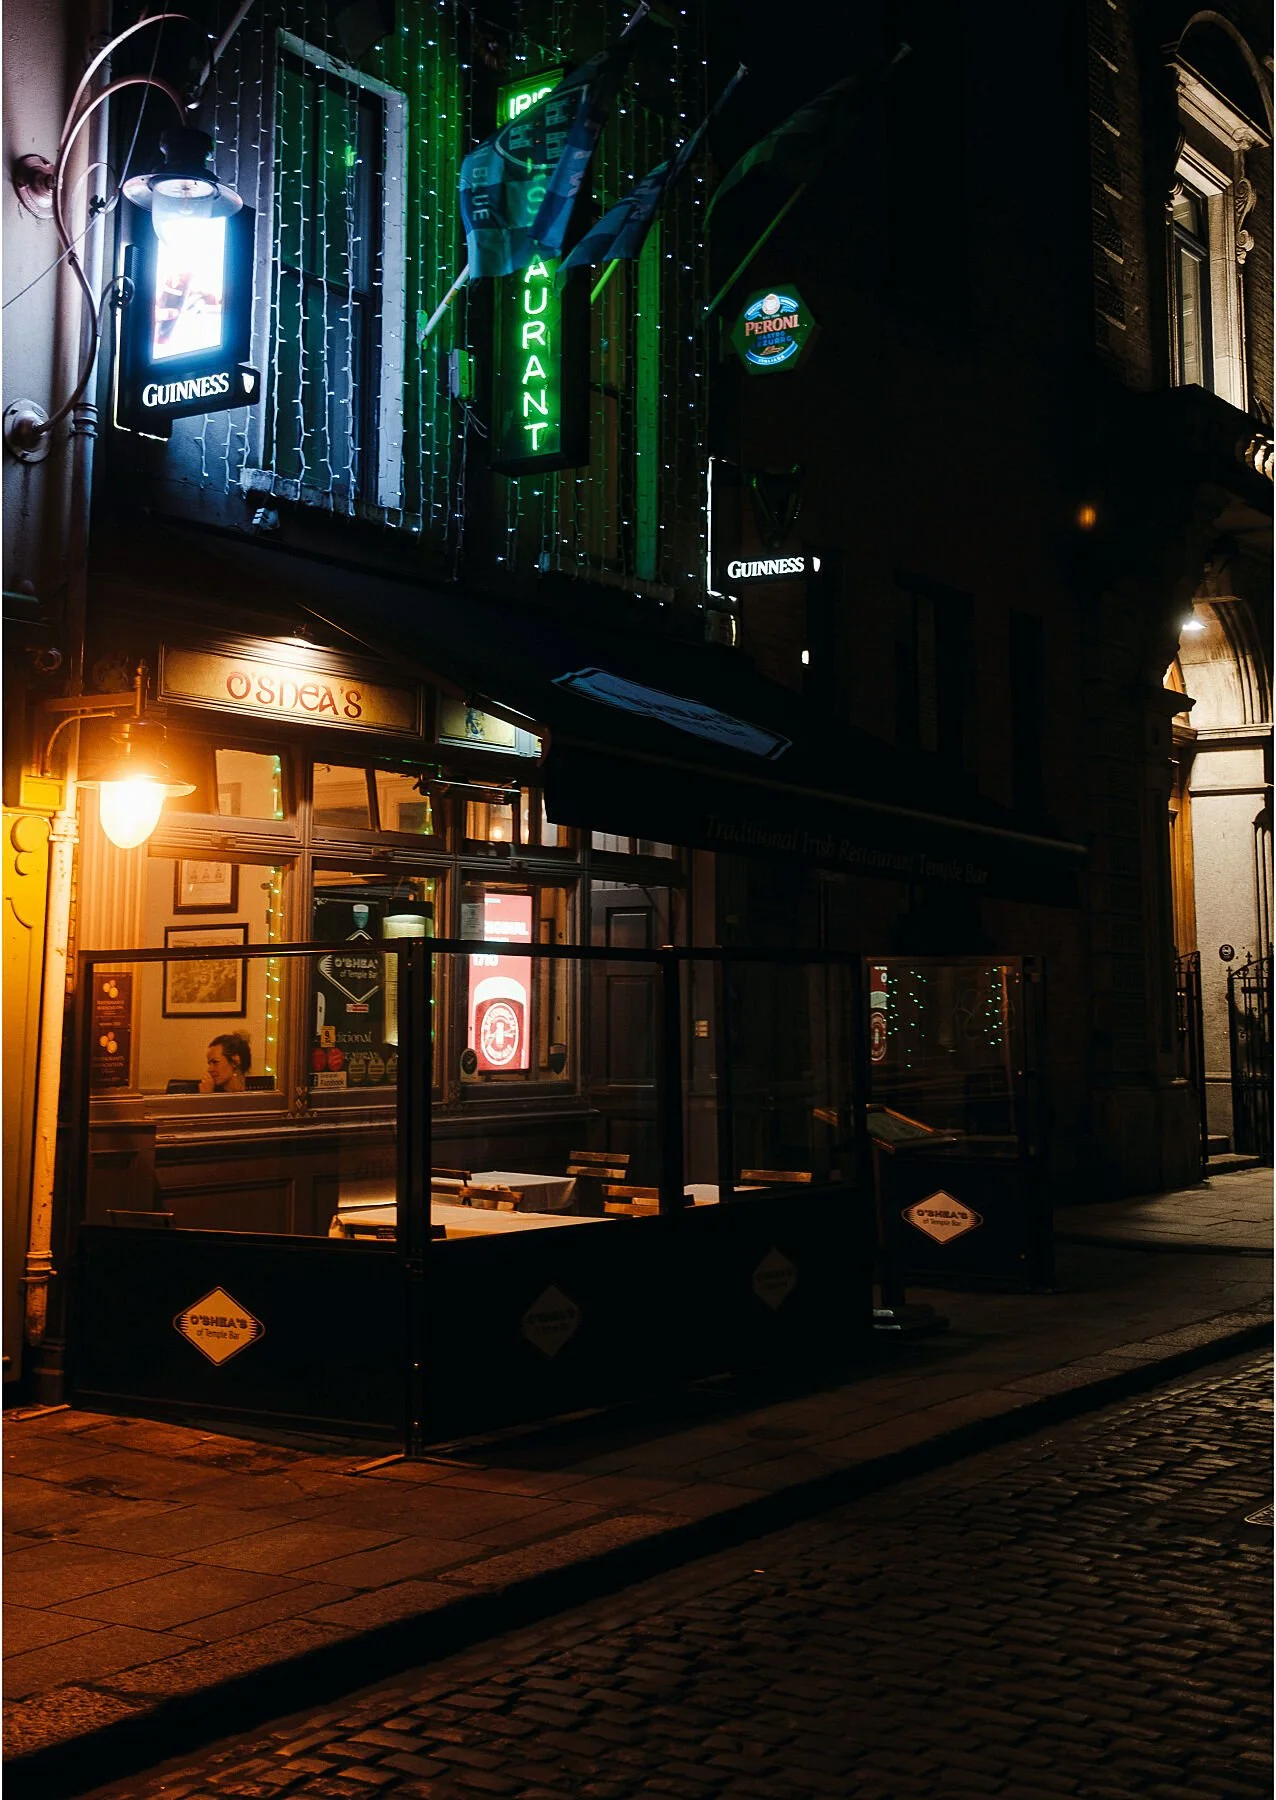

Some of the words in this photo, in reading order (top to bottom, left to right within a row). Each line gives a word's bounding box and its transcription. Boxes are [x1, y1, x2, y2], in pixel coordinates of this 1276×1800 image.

[745, 315, 800, 337] PERONI
[142, 372, 229, 407] GUINNESS
[727, 557, 805, 579] GUINNESS
[334, 957, 379, 969] O'SHEA'
[917, 1209, 968, 1220] O'SHEA'S
[190, 1315, 249, 1330] O'SHEA'S
